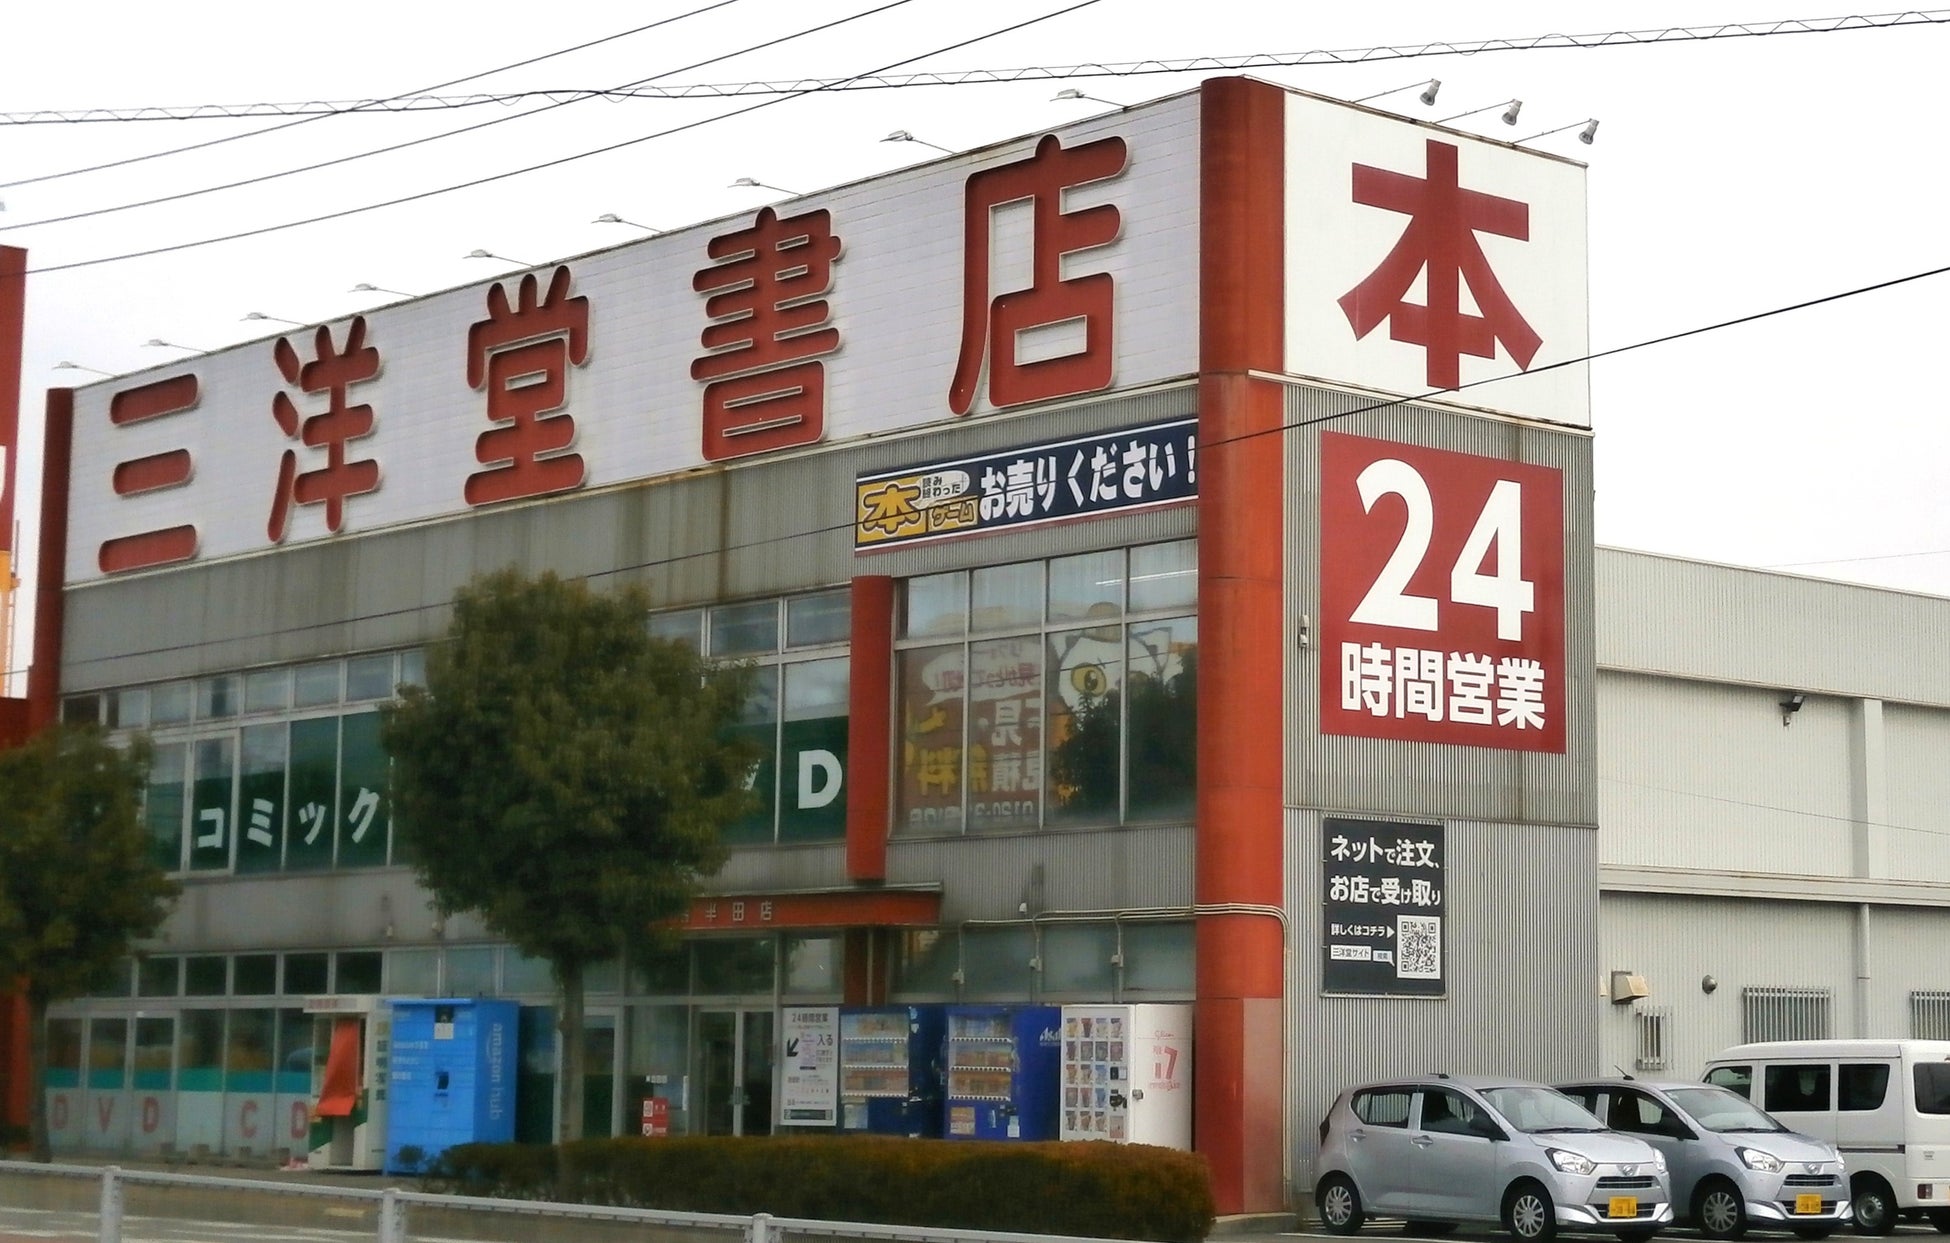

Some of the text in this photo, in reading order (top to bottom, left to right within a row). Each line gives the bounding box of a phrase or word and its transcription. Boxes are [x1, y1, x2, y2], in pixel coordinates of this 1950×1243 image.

[1337, 138, 1543, 392] 本
[97, 133, 1131, 574] 三洋堂書店
[862, 481, 922, 535] 本
[931, 501, 975, 527] ゲーム
[1348, 458, 1534, 642] 24
[1340, 641, 1546, 731] 時間営業
[197, 786, 380, 848] コミック
[1330, 834, 1440, 869] ネットで注文、
[1329, 874, 1441, 907] お店で受け取り
[1330, 922, 1386, 938] 詳しくはコチラ
[488, 1023, 503, 1083] amazon
[53, 1096, 160, 1134] DVD
